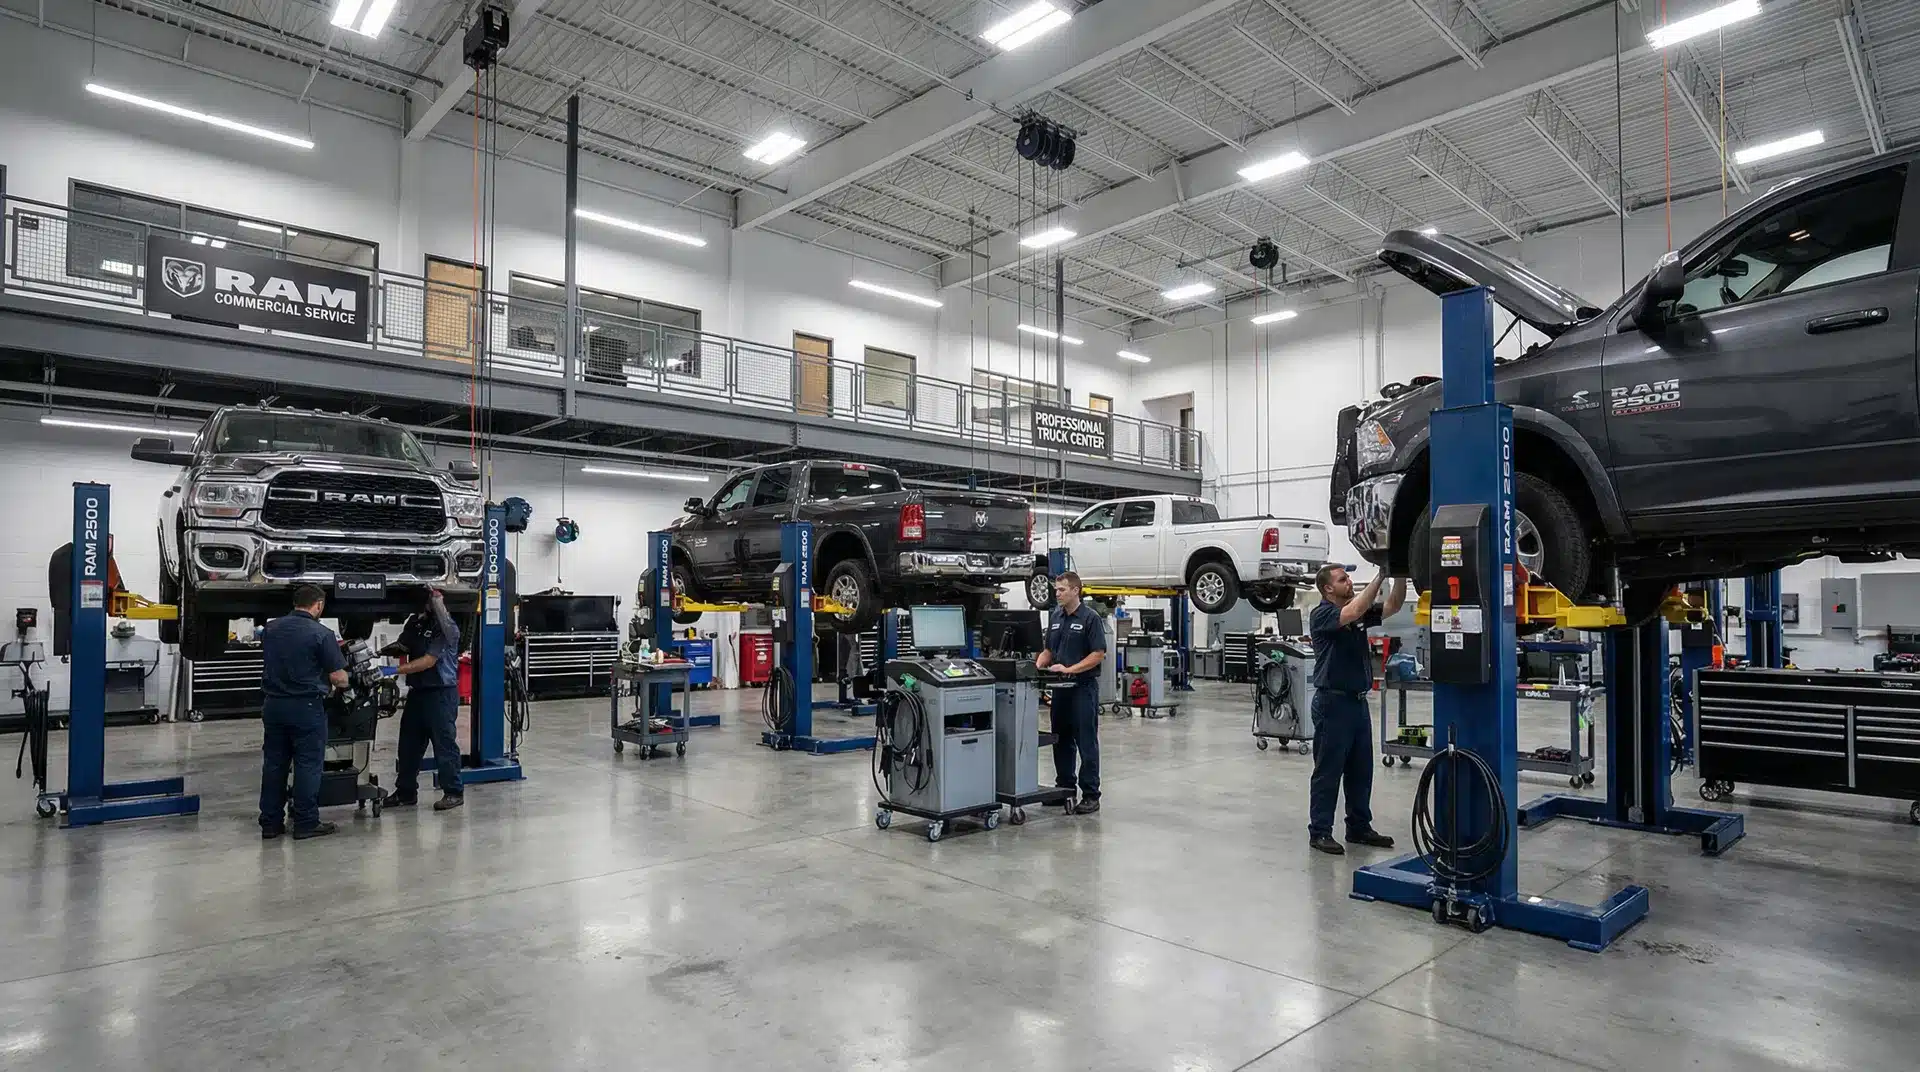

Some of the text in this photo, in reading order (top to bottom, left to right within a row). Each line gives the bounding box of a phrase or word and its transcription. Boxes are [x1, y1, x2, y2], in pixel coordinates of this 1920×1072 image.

[215, 267, 356, 311] RAM
[214, 292, 355, 325] COMMERCIAL SERVICE
[1611, 378, 1679, 398] RAM
[1611, 391, 1680, 409] 2500
[1035, 411, 1105, 435] PROFESSIONAL
[1037, 426, 1105, 449] TRUCK CENTER
[1503, 426, 1511, 495] 2500
[324, 492, 397, 505] RAM
[85, 497, 99, 540] 2500
[84, 542, 97, 576] RAM
